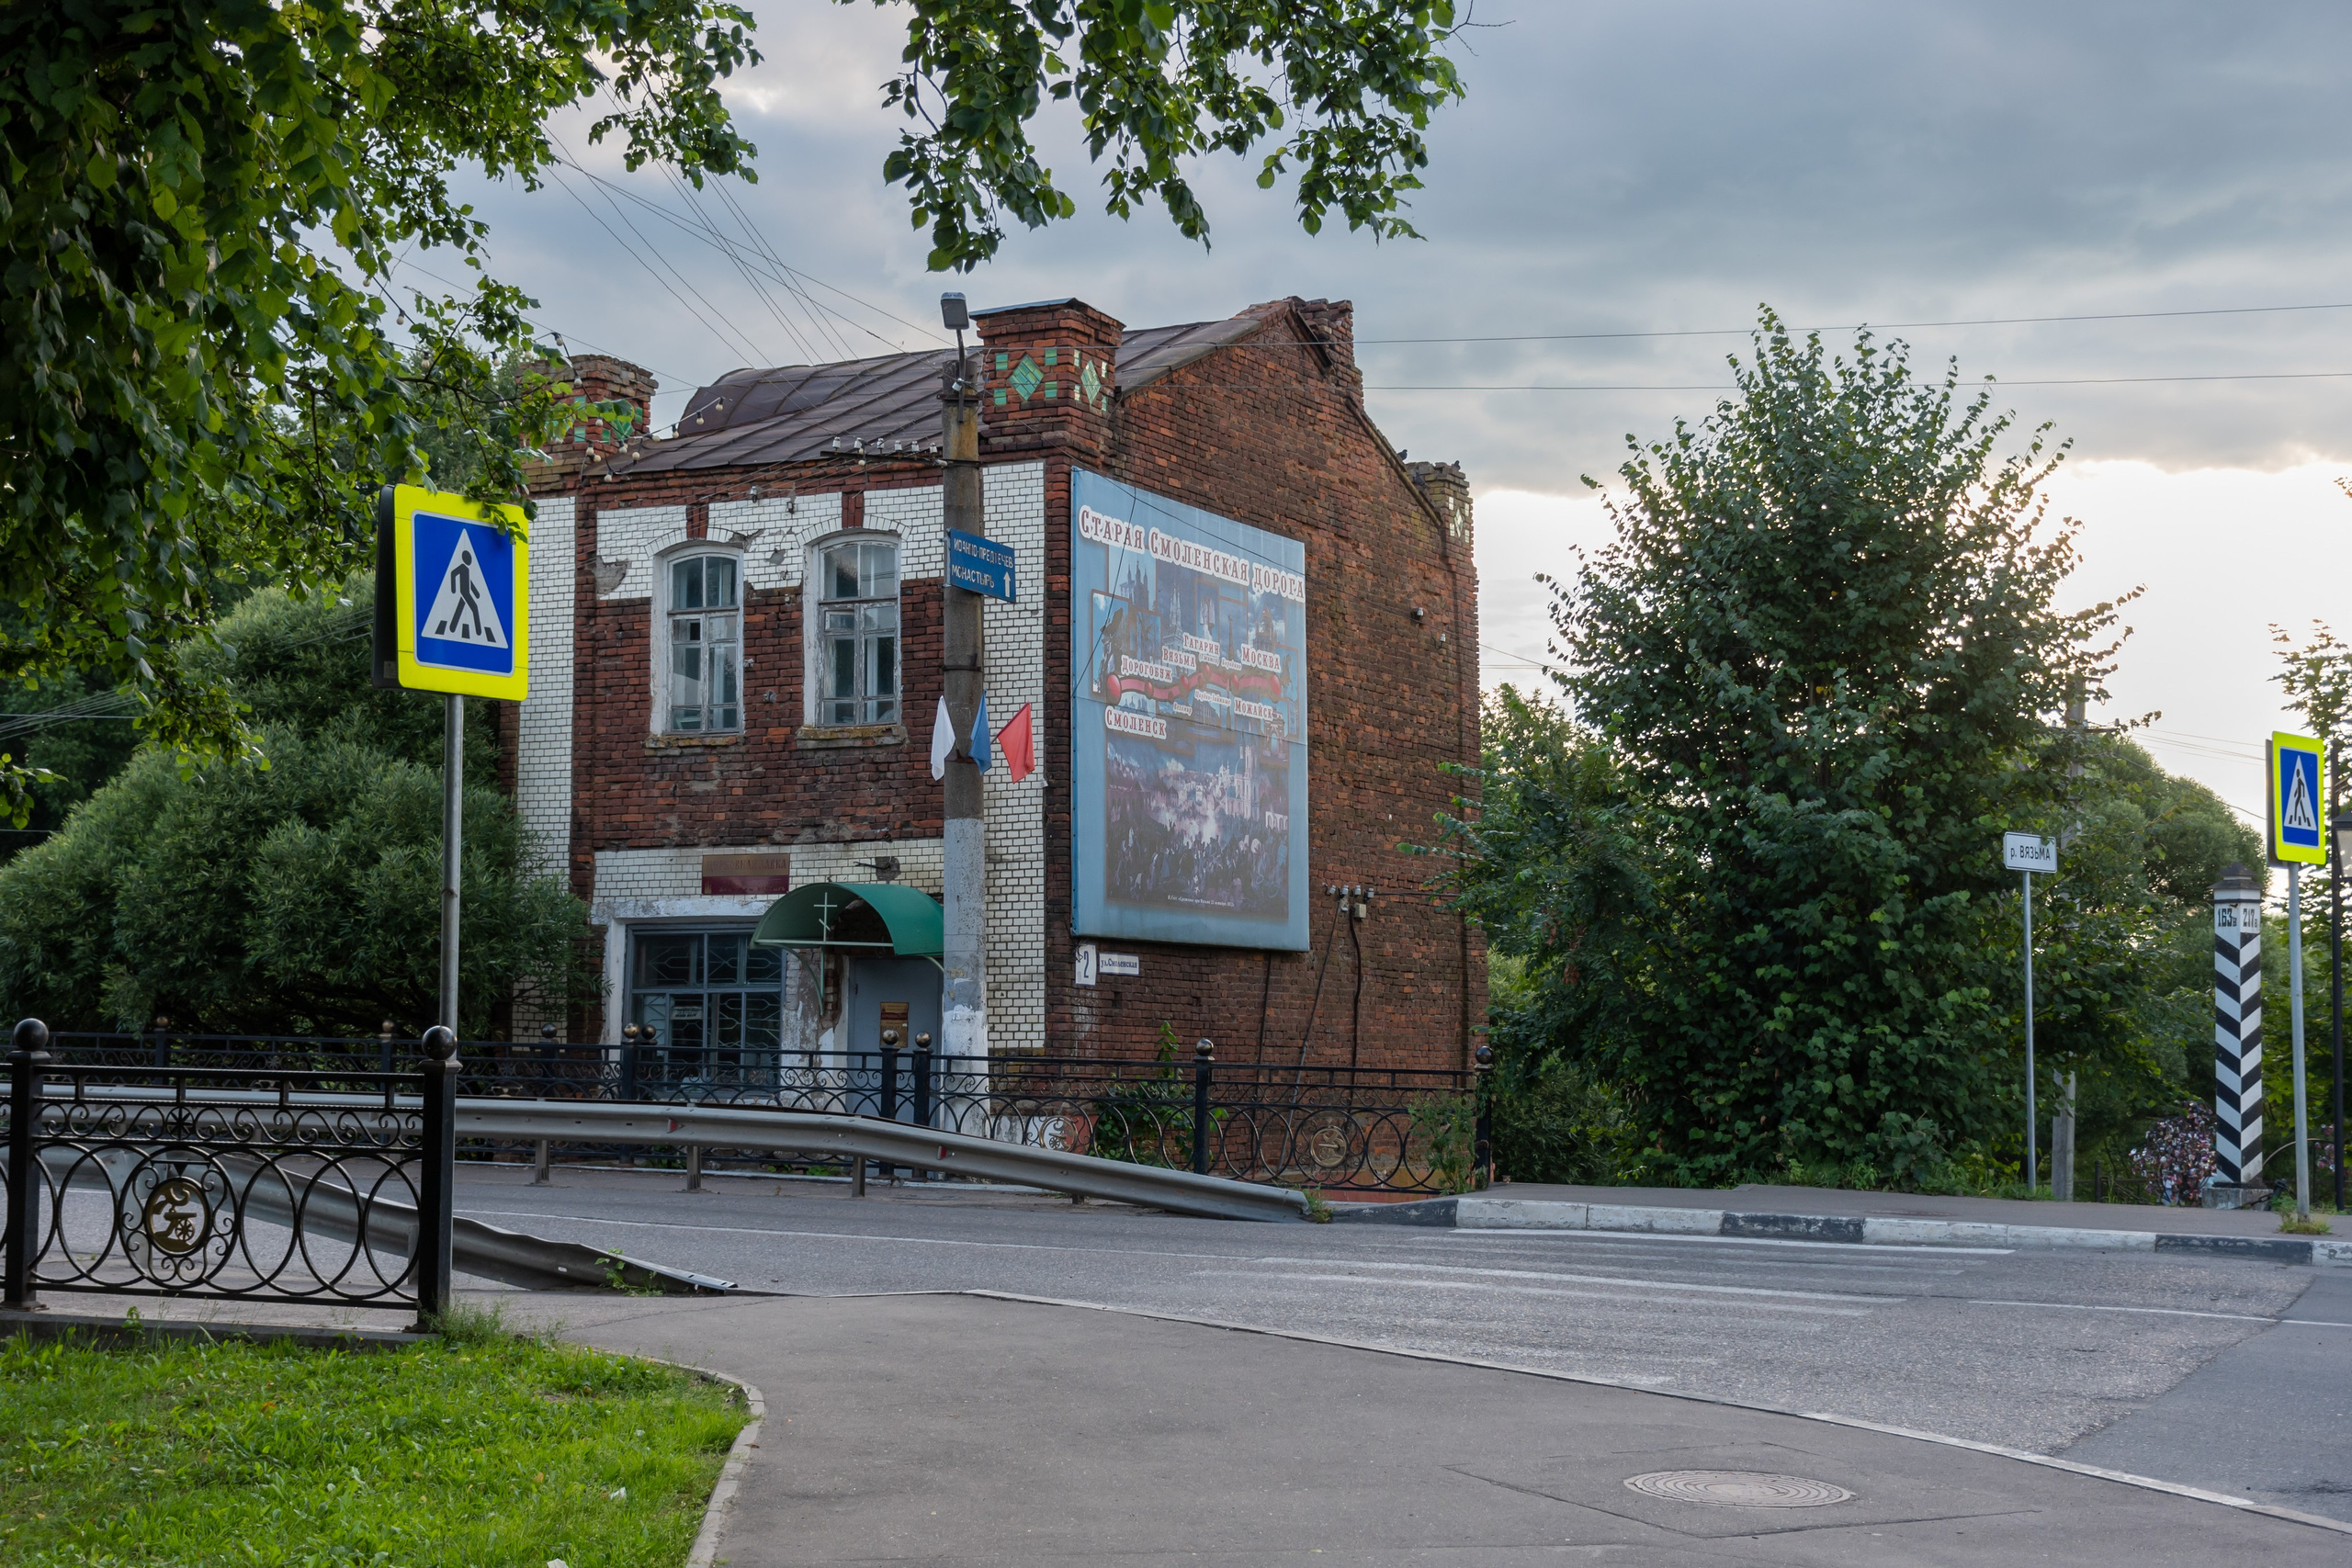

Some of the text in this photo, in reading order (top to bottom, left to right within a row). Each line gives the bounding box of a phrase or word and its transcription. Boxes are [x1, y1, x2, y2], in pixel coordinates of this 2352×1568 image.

[1081, 510, 1305, 599] СТАРАЯ СМОЛЕНСКАЯ ДОРОГА
[952, 564, 995, 588] МОНАСТЫРЬ
[1182, 634, 1220, 656] ГАГАРИН
[1122, 657, 1172, 681] ДОРОГОБУЖ
[1162, 648, 1196, 668] ВЯЗЬМА
[1242, 646, 1281, 671] МОСКВА
[1235, 699, 1272, 720] МОЖАЙСК
[1106, 708, 1166, 737] СМОЛЕНСК
[2019, 845, 2052, 861] ВЯЗЬМА
[1083, 950, 1090, 978] 2
